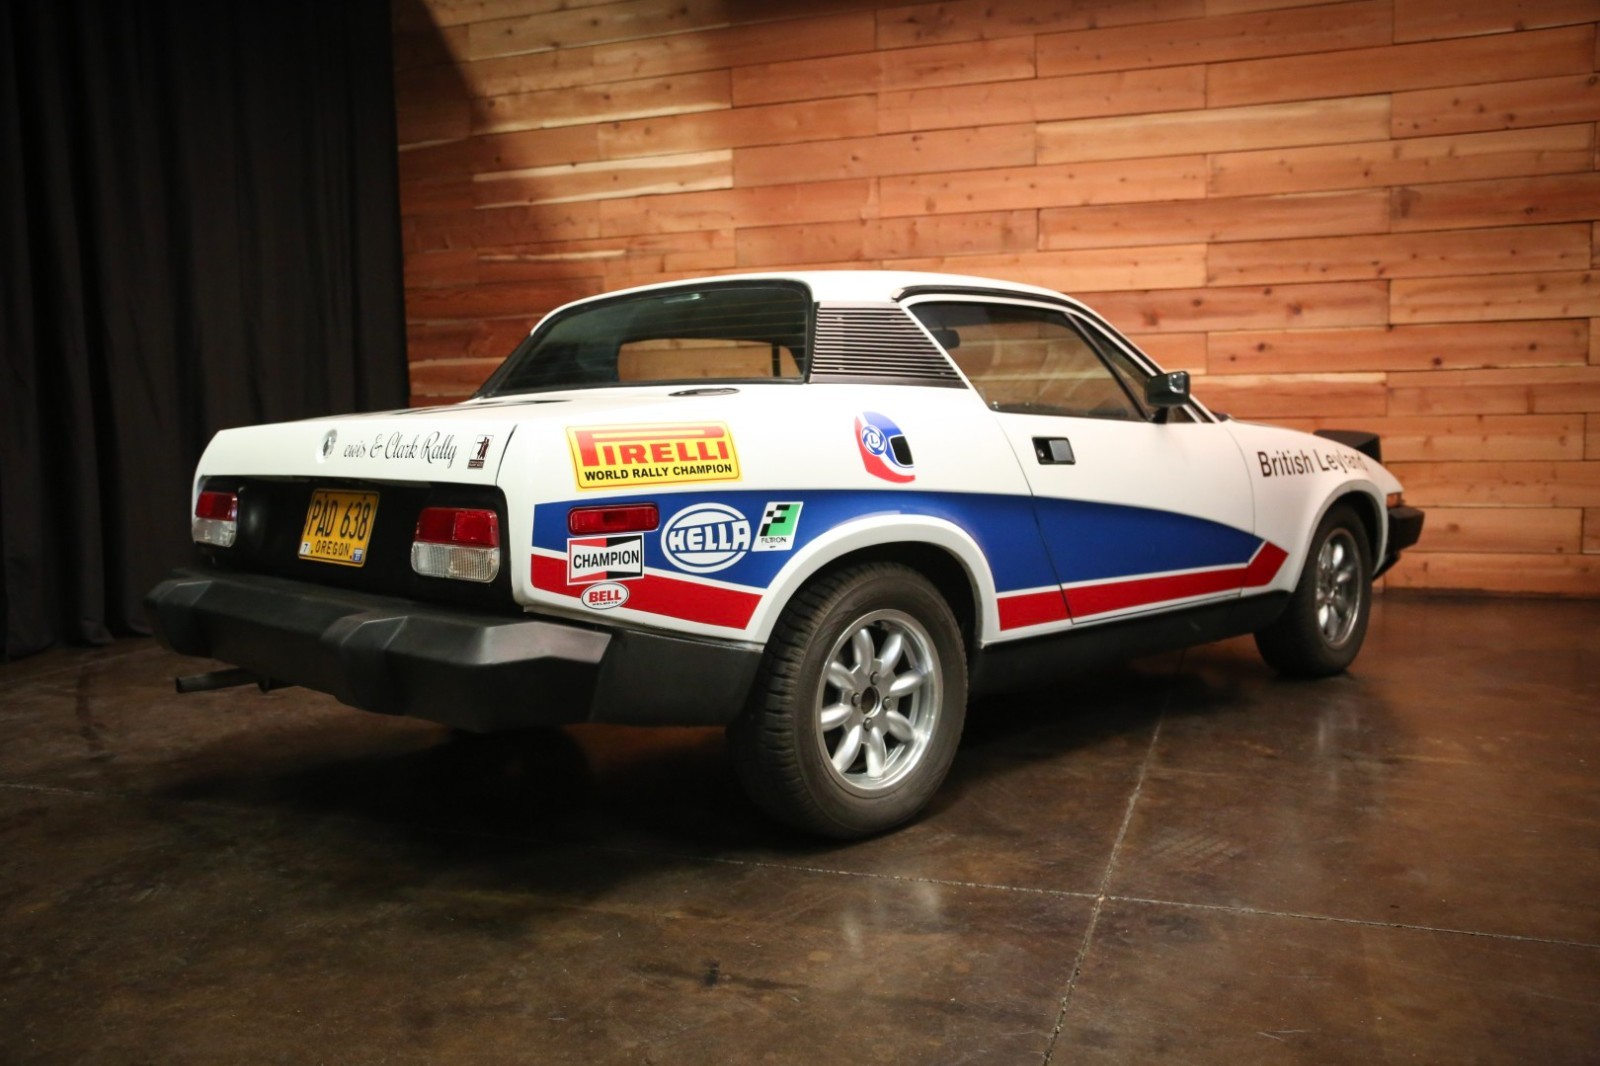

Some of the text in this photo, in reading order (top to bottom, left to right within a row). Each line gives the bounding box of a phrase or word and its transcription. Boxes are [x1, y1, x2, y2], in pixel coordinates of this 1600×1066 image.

[369, 433, 383, 459] &
[385, 431, 418, 460] Clark
[420, 431, 458, 469] Rally
[575, 426, 730, 467] PIRELLI
[584, 464, 732, 481] WORLD RALLY CHAMPION
[1257, 449, 1315, 477] British
[307, 500, 371, 541] PAD 638
[668, 520, 751, 551] HELLA
[760, 536, 787, 544] FILTRON
[315, 540, 351, 556] OREGON
[573, 550, 640, 569] CHAMPION
[589, 590, 622, 603] BELL
